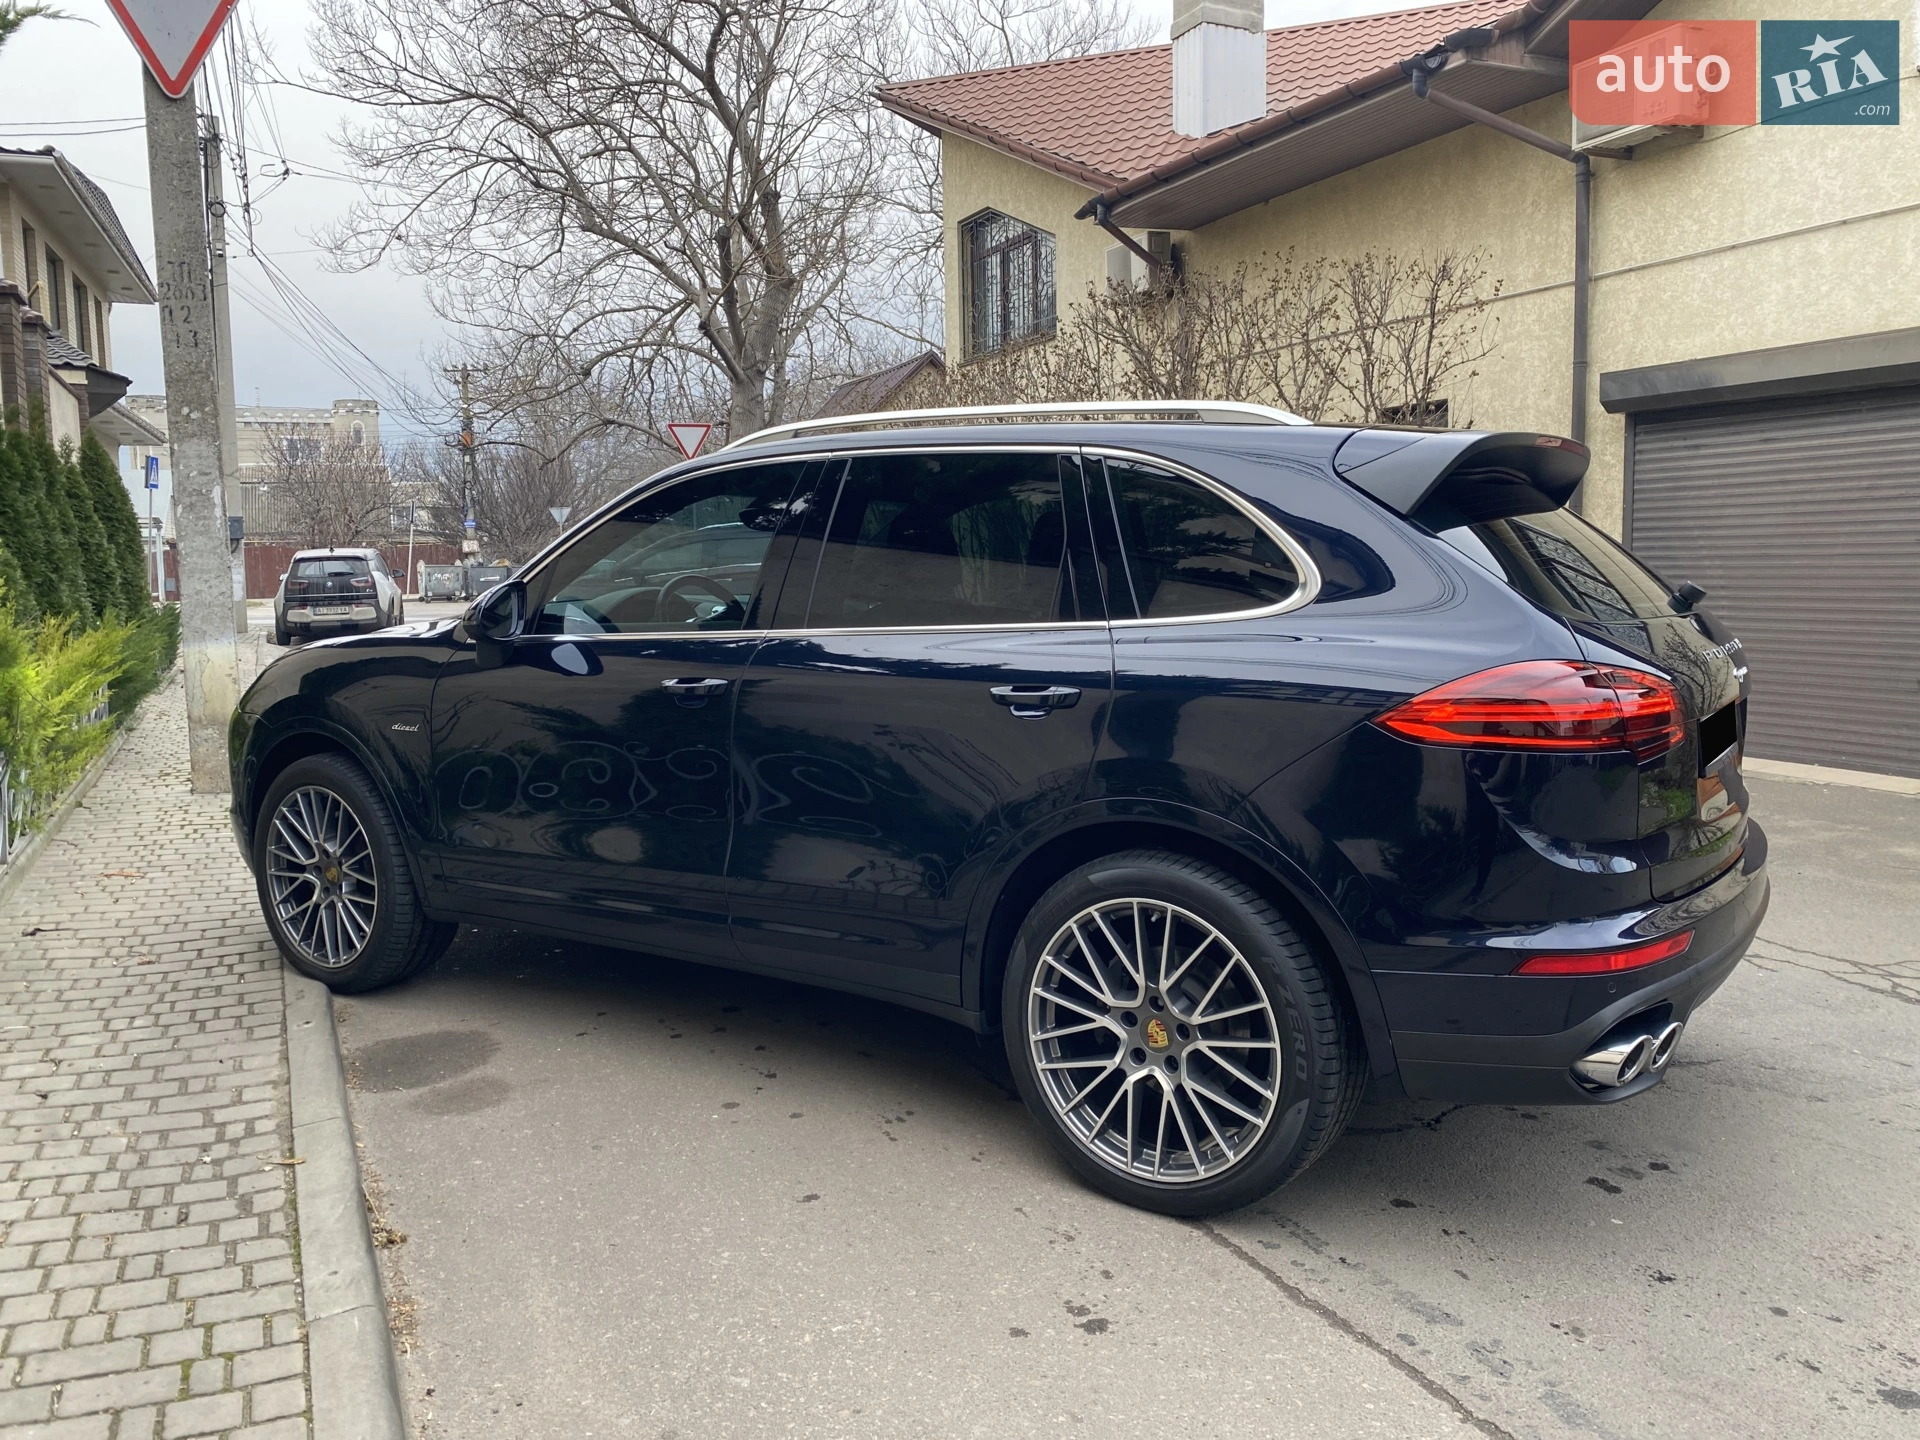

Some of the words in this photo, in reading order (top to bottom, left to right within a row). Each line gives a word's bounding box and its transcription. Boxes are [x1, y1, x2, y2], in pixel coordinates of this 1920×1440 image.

[391, 722, 420, 732] diesel
[1260, 955, 1282, 975] P
[1276, 983, 1308, 1082] ZERO
